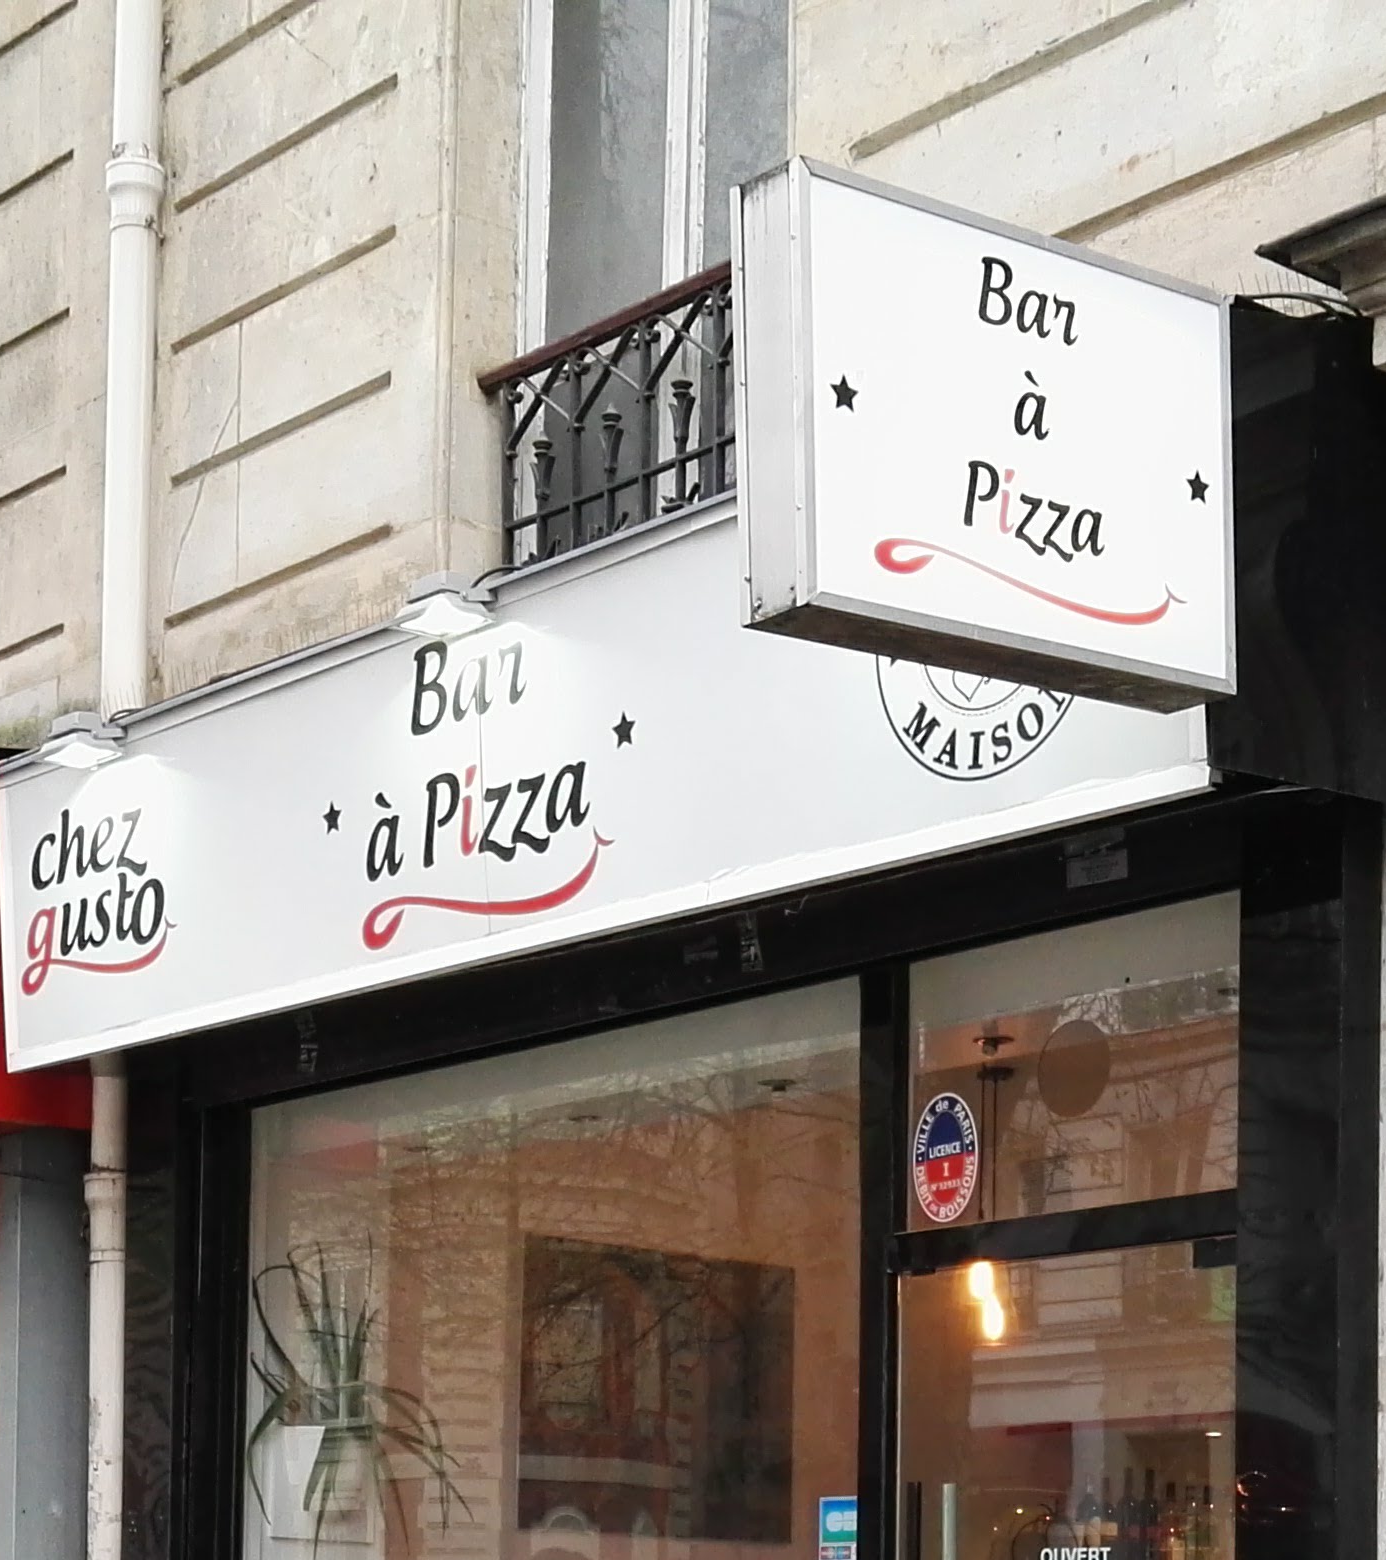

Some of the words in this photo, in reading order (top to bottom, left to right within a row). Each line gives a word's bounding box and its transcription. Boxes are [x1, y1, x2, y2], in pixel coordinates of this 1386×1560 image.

[978, 256, 1079, 346] Bar
[1013, 370, 1050, 441] à
[963, 460, 1105, 563] Pizza
[410, 640, 527, 736] Bar
[31, 808, 147, 891] chez
[366, 792, 405, 882] à
[423, 760, 591, 868] Pizza
[21, 872, 169, 996] gusto
[916, 1112, 934, 1154] VILLE
[935, 1100, 949, 1113] de
[954, 1103, 974, 1144] PARIS
[929, 1141, 962, 1159] LICENCE
[938, 1156, 975, 1219] BOISSONS
